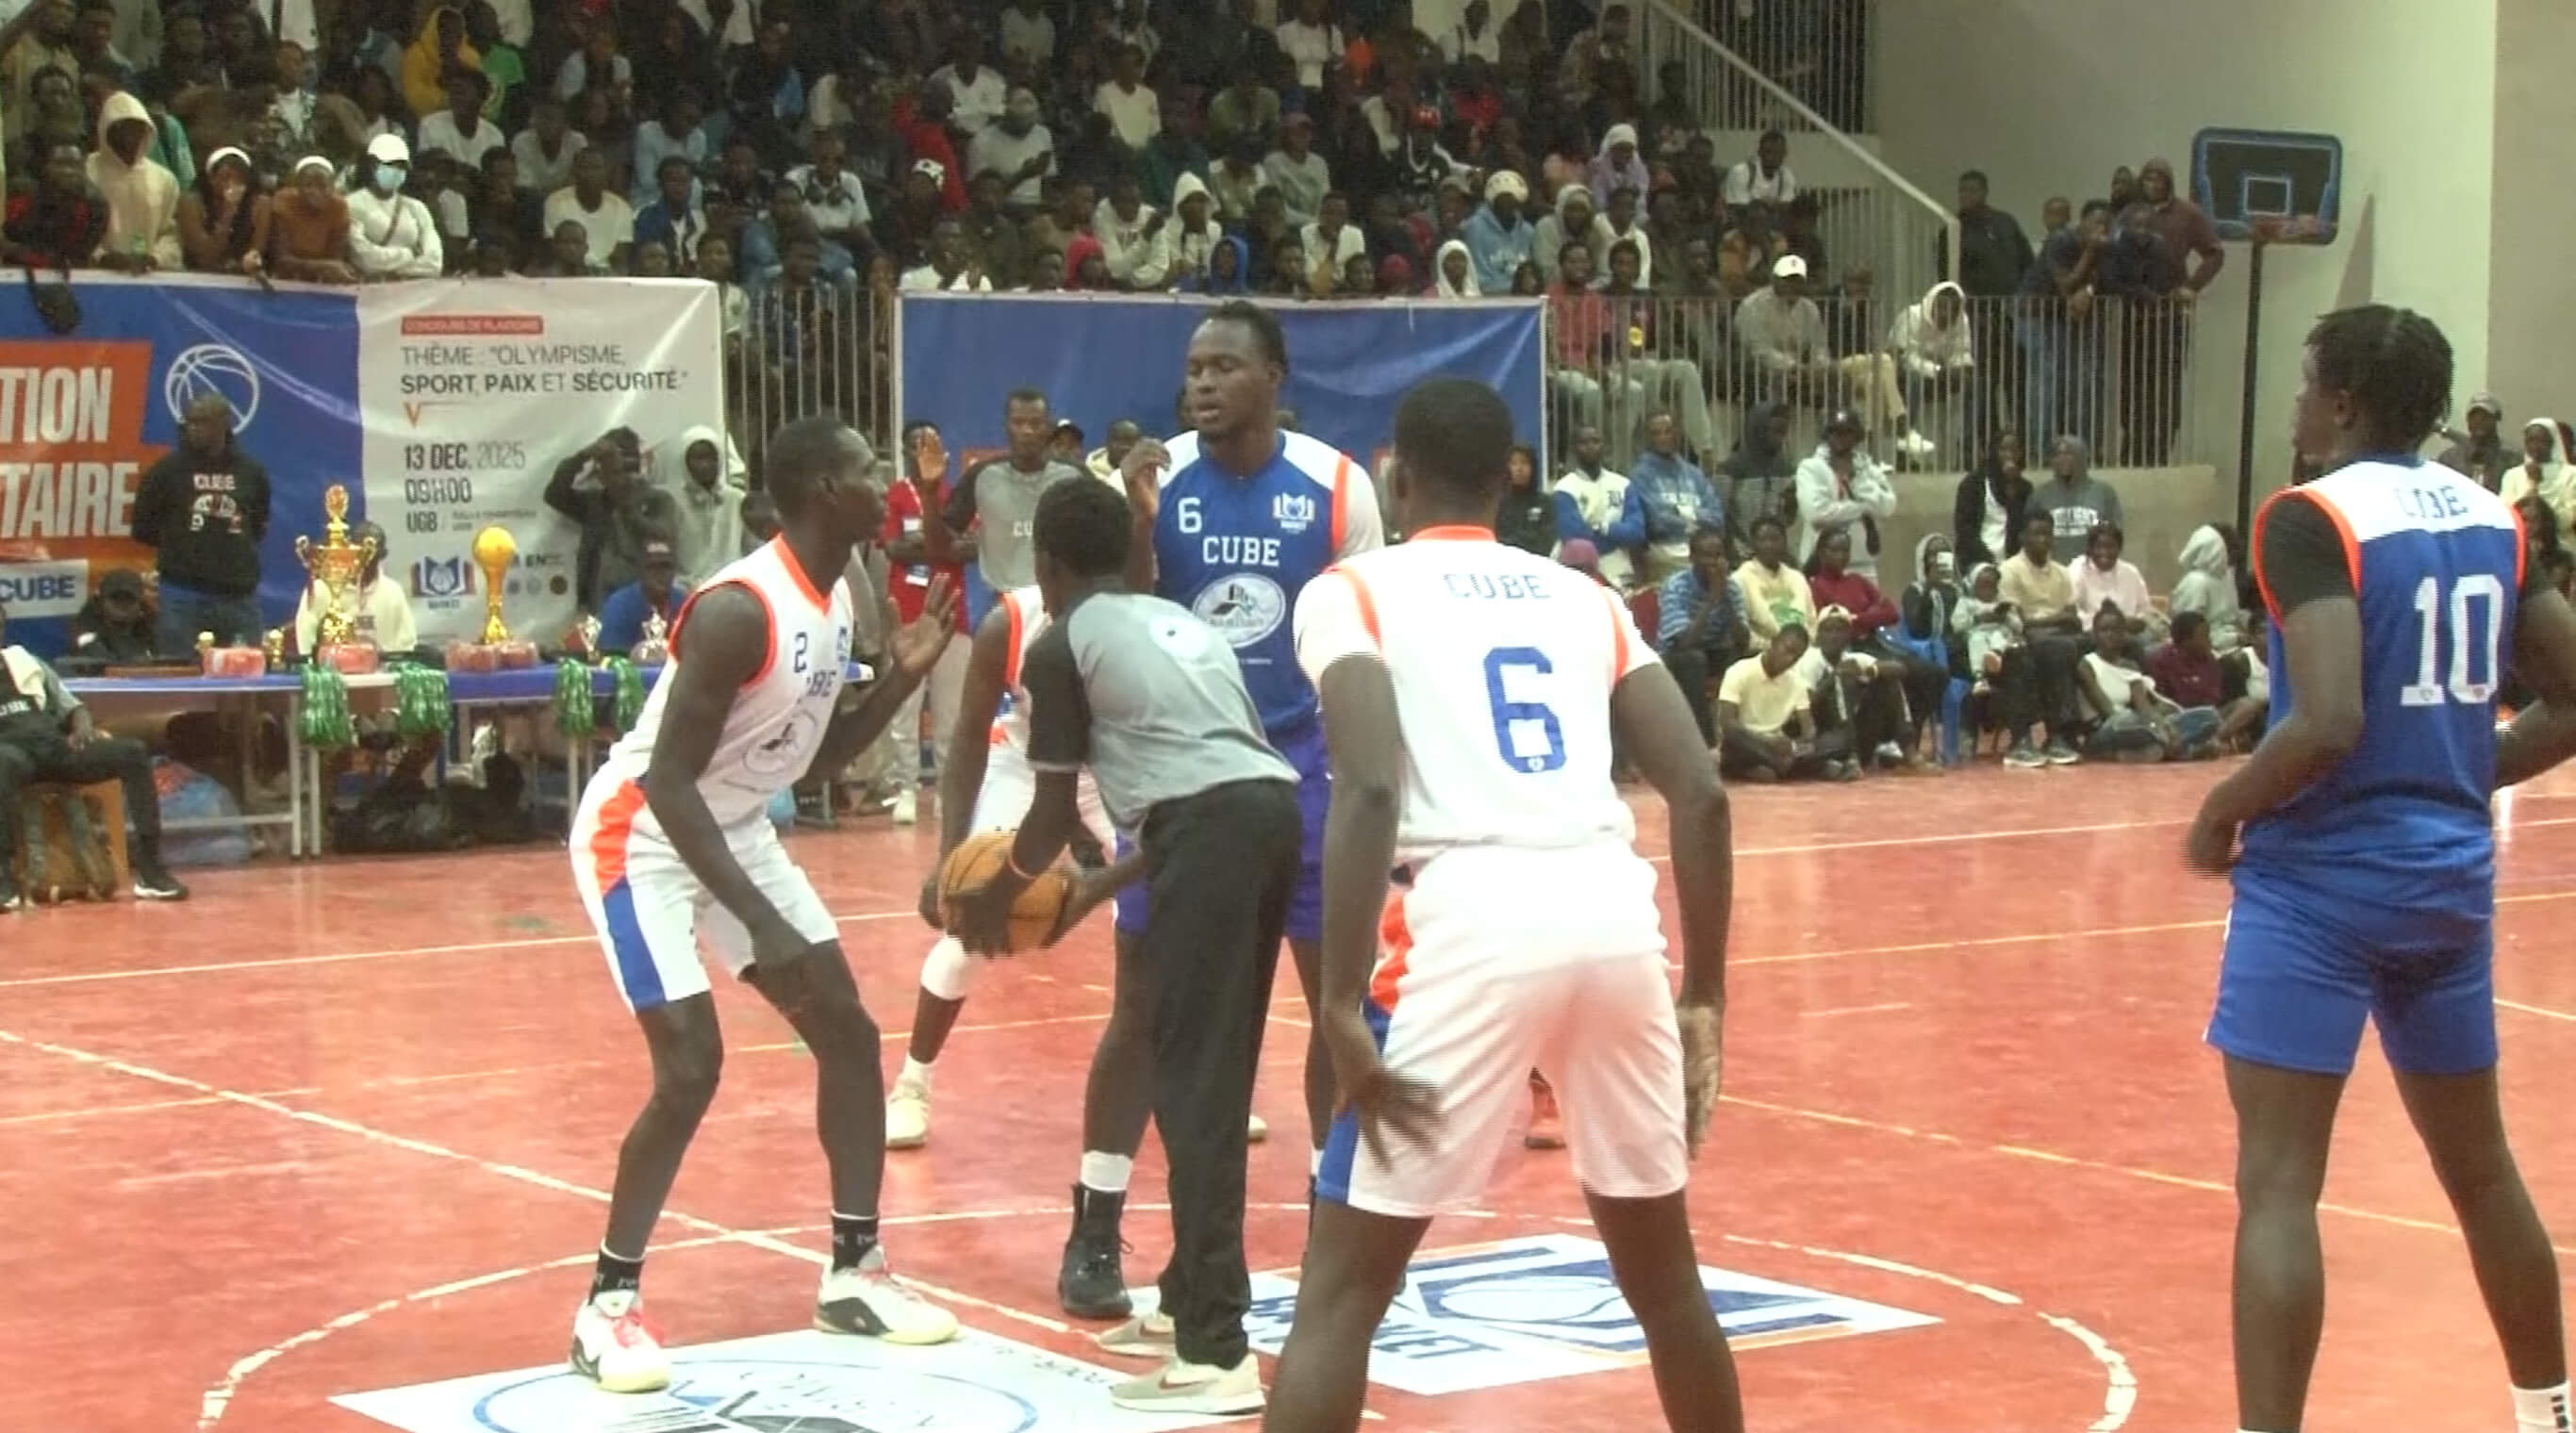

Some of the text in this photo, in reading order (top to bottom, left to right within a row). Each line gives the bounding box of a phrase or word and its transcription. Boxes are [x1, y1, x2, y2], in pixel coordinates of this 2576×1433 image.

[401, 340, 472, 366] THÈME
[485, 373, 537, 393] PAIX
[542, 372, 566, 391] ET
[405, 443, 424, 470] 13
[476, 440, 526, 470] 2025
[405, 477, 472, 503] 09H00
[406, 510, 438, 534] UGB
[1013, 519, 1033, 537] CU
[1179, 497, 1202, 534] 6
[1202, 535, 1280, 567] CUBE
[0, 574, 76, 602] CUBE
[1443, 573, 1551, 600] CUBE
[793, 631, 809, 673] 2
[2400, 573, 2504, 706] 10
[1483, 647, 1567, 773] 6
